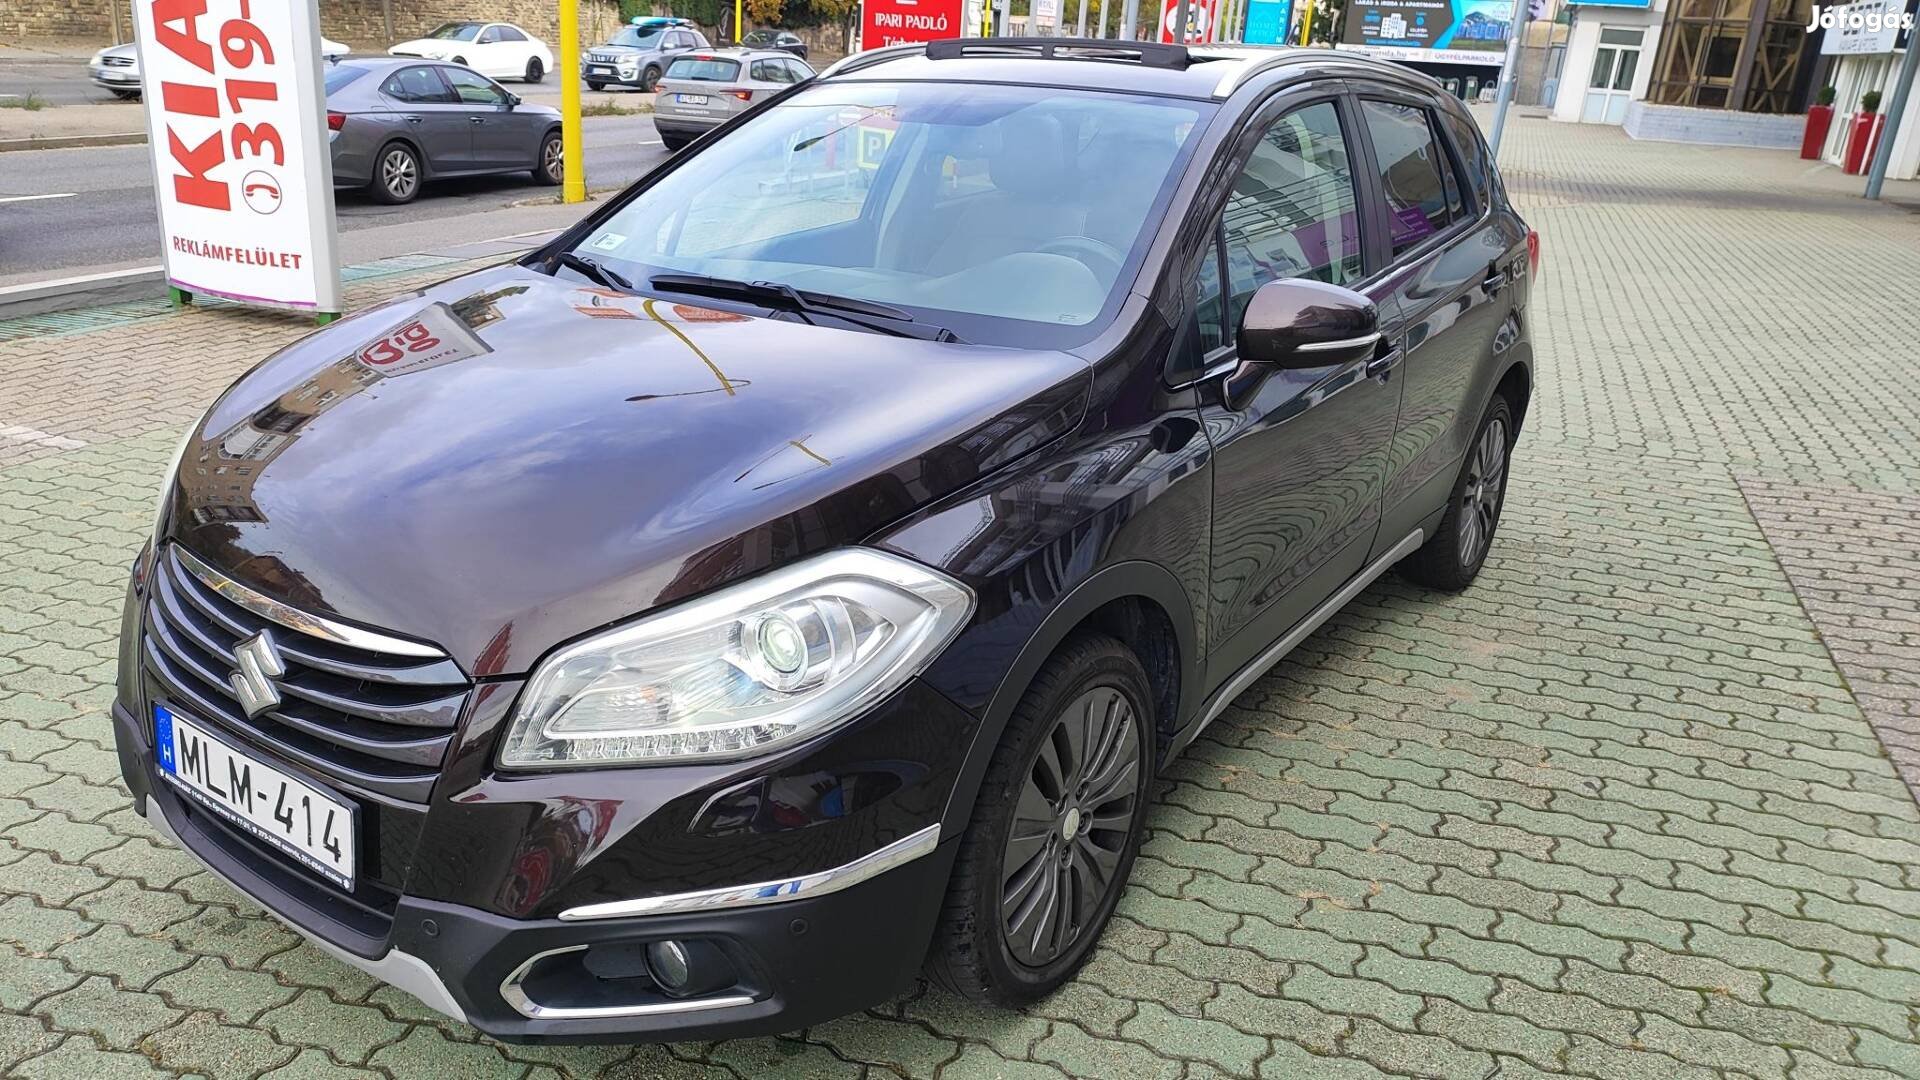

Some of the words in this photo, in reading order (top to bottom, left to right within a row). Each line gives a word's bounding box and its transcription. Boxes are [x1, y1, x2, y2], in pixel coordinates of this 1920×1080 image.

[875, 12, 902, 28] IPARI
[905, 12, 948, 31] PADLÓ
[867, 135, 882, 157] P
[173, 235, 302, 270] REKLÁMFELÜLET
[163, 744, 172, 764] H
[179, 727, 342, 863] MLM-414
